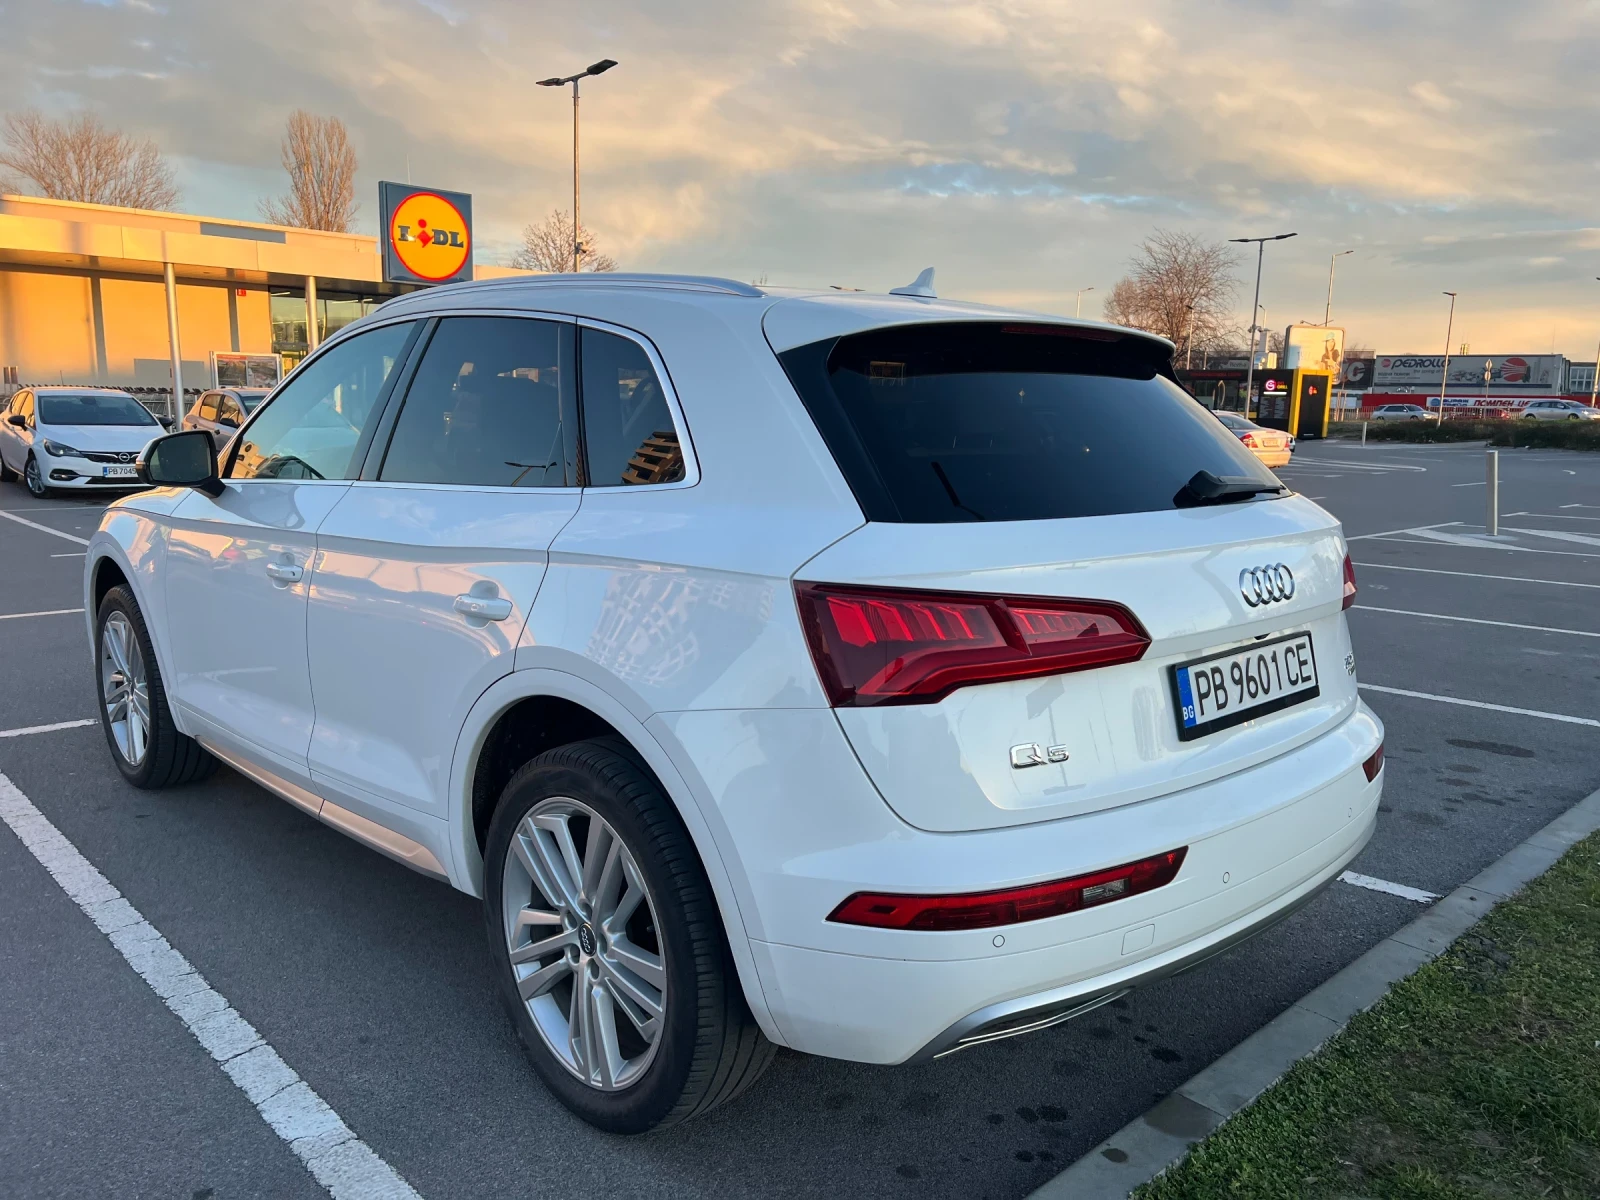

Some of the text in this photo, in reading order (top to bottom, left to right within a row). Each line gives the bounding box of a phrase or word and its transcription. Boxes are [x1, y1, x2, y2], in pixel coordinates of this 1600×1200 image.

[1194, 665, 1229, 716] PB
[1230, 650, 1283, 704] 9601
[1284, 642, 1312, 686] CE
[1183, 705, 1194, 720] BG
[1008, 742, 1069, 769] Q5
